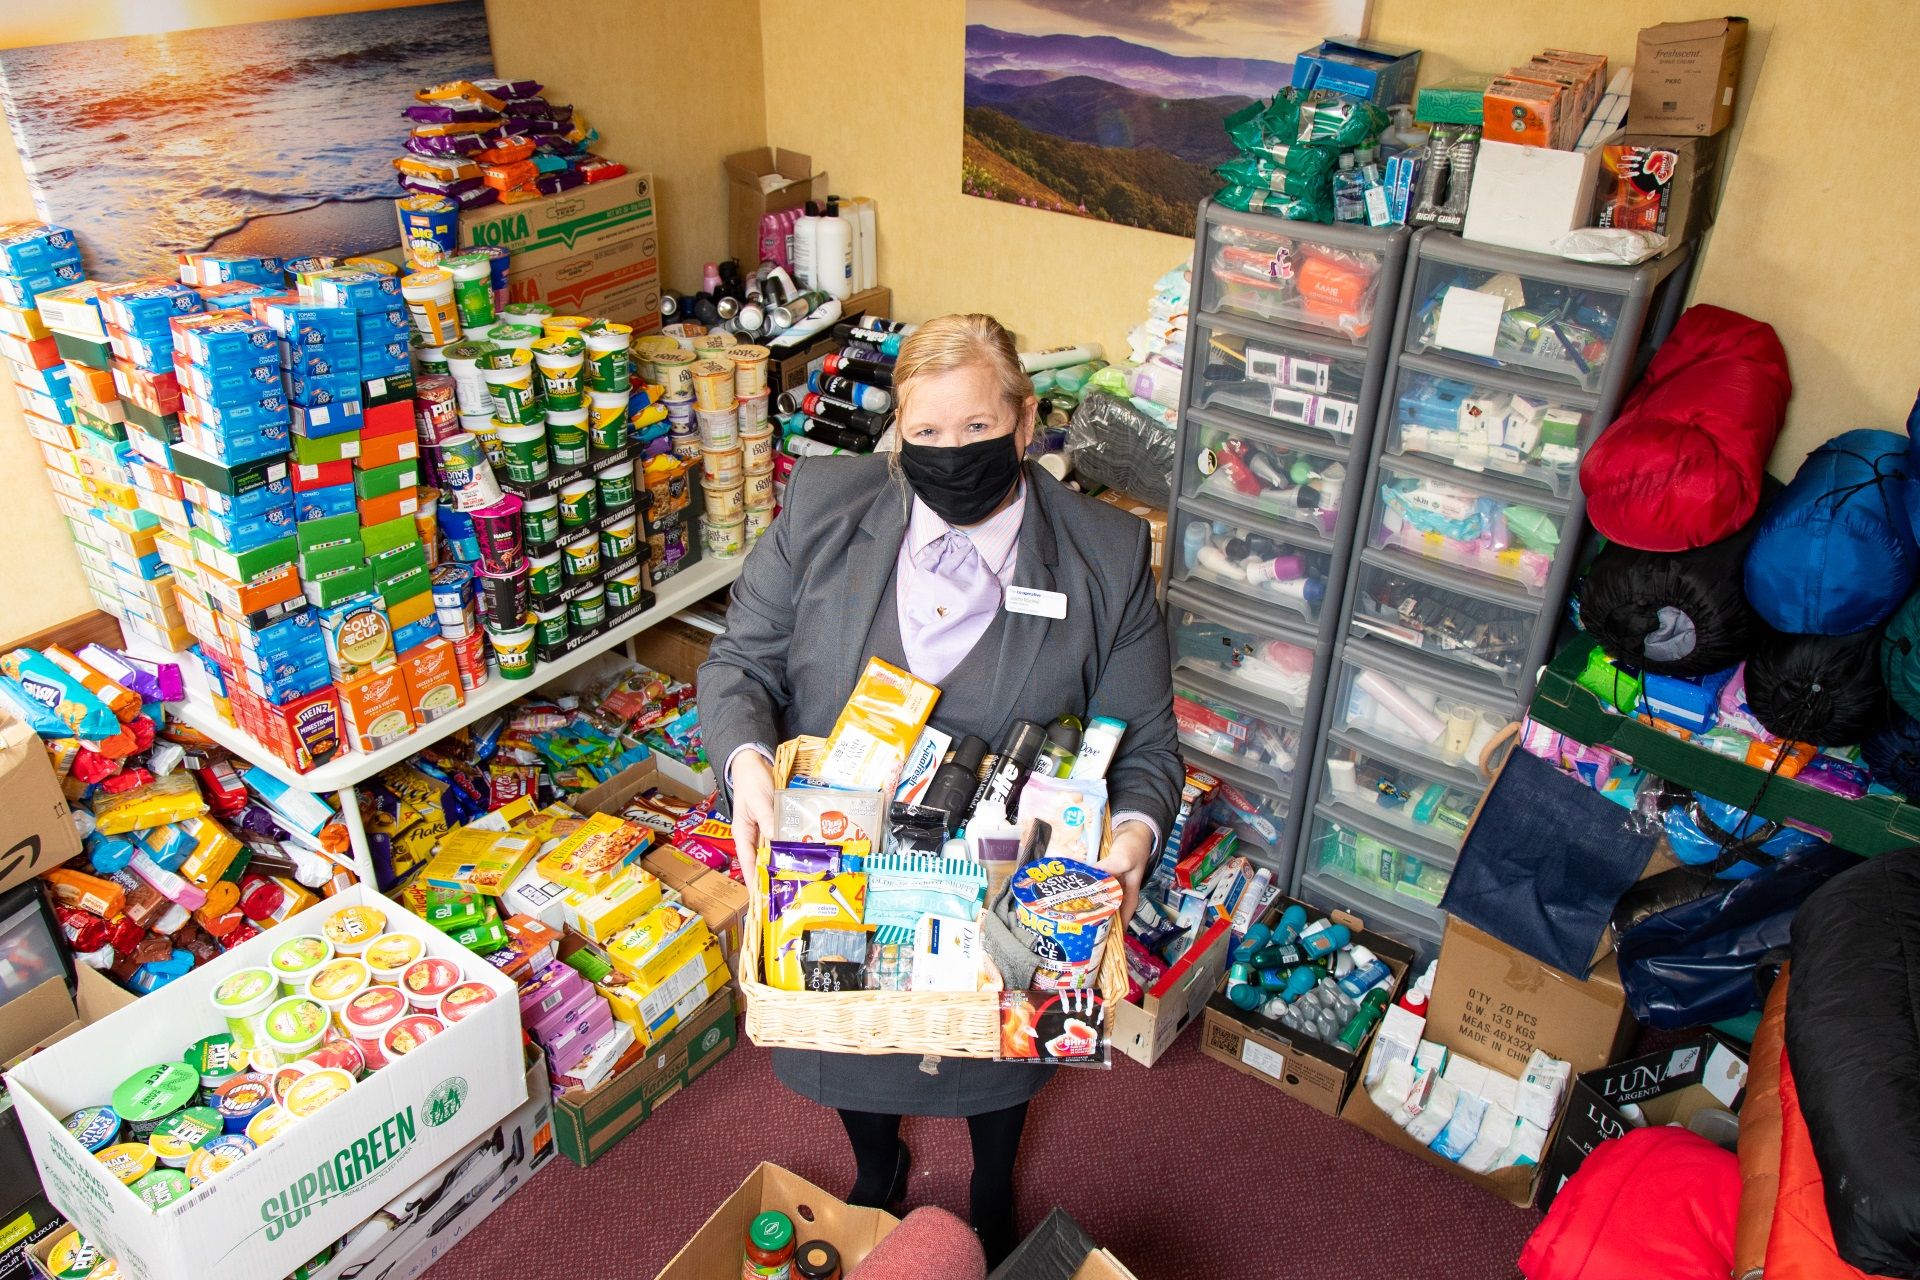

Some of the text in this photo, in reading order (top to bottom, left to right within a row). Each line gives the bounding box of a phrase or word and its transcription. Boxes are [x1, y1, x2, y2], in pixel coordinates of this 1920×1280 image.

[1416, 212, 1462, 225] RIGHT GUARD
[410, 227, 434, 239] BIG
[472, 213, 530, 247] KOKA
[548, 475, 564, 490] POT
[493, 530, 513, 539] NAKED
[555, 534, 573, 548] POT
[560, 587, 577, 602] POT
[343, 613, 376, 633] SOUP
[355, 623, 379, 642] CUP
[354, 639, 377, 652] CHICKEN
[566, 636, 583, 651] POT
[498, 651, 528, 663] POT
[302, 703, 328, 721] HEINZ
[299, 715, 335, 735] MINESTRONE
[1080, 741, 1100, 757] Dove
[908, 739, 937, 788] Aquafresh
[1222, 783, 1250, 811] Colgate
[1026, 860, 1066, 883] BIG
[1042, 879, 1088, 897] SAUCE
[1018, 908, 1055, 937] BIG
[617, 923, 653, 952] belVita
[963, 926, 974, 960] Dove
[1499, 1003, 1514, 1016] 20
[1516, 1010, 1538, 1027] PCS
[1492, 1013, 1512, 1029] 13.5
[1515, 1024, 1536, 1040] KGS
[1459, 1024, 1530, 1065] MADE IN CHIN
[145, 1063, 170, 1086] RICE
[1617, 1085, 1662, 1103] ARGENTA
[260, 1104, 417, 1242] SUPAGREEN
[29, 1217, 60, 1243] Luxury
